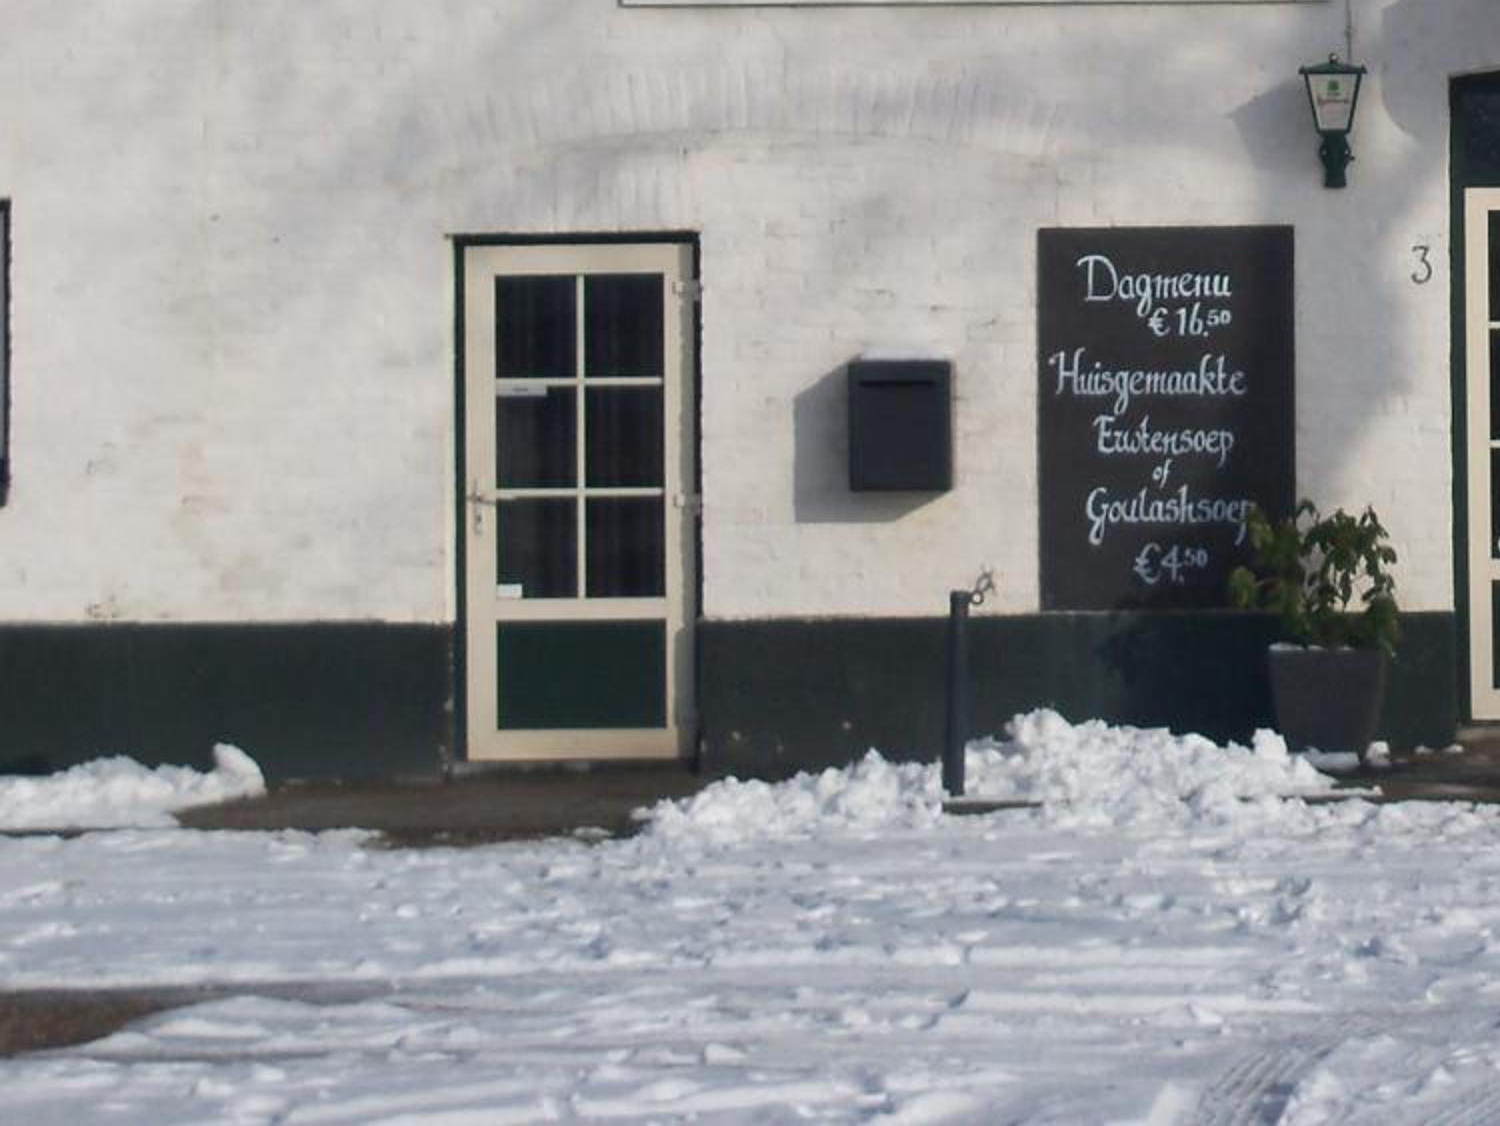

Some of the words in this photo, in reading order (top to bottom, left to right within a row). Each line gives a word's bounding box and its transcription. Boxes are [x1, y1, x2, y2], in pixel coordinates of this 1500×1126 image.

[1077, 255, 1233, 317] Dagmenu
[1411, 245, 1432, 285] 3
[1048, 346, 1247, 415] Huisgemaakte
[1093, 415, 1235, 467] Erwtensoep
[1152, 458, 1173, 489] of
